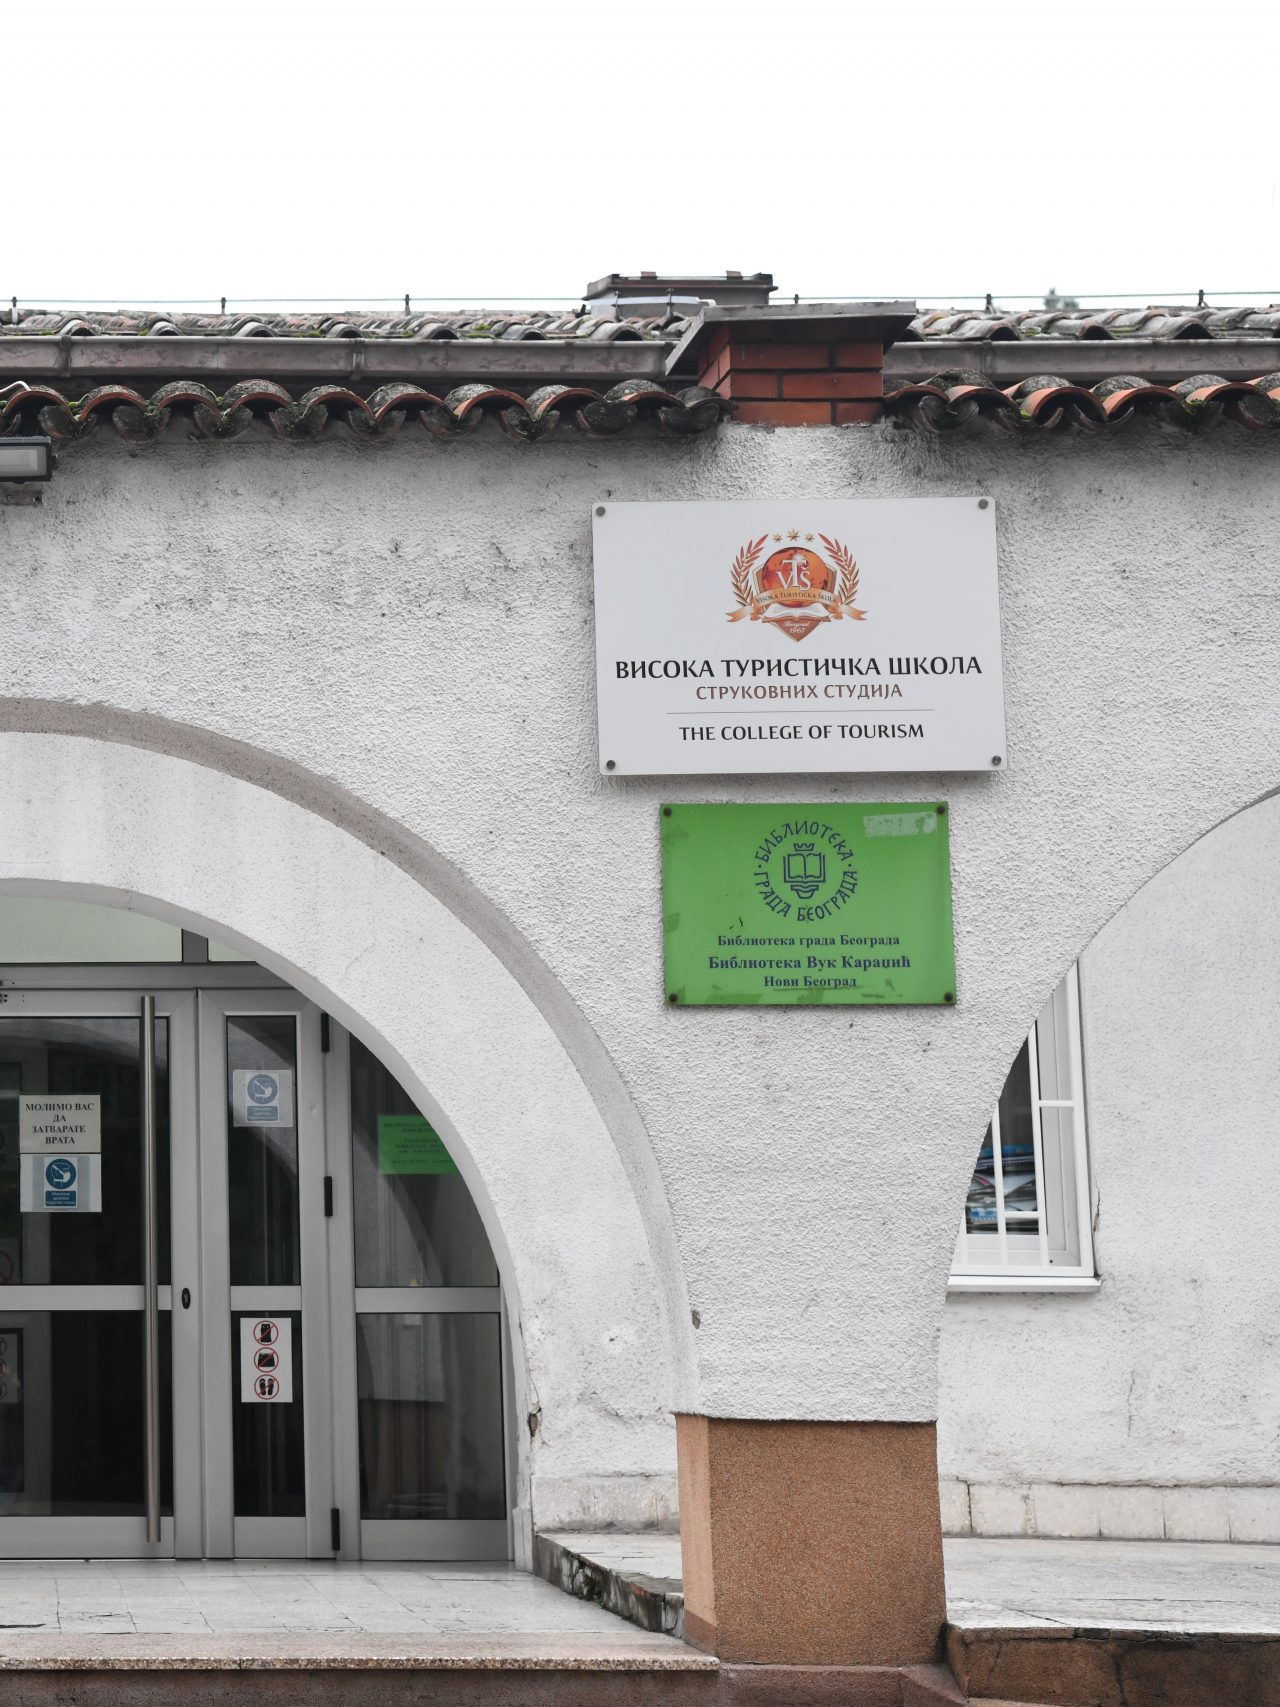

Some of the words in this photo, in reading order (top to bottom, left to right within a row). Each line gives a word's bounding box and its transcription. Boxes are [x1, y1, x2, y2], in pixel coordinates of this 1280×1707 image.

[616, 659, 714, 679] ВИСОКА
[721, 657, 881, 678] ТУРИСТИЧКА
[888, 655, 982, 676] ШКОЛА
[695, 684, 818, 701] СТРУКОВНИХ
[823, 683, 903, 701] СТУДИЈА
[678, 726, 715, 741] THE
[721, 725, 803, 741] COLLEGE
[808, 724, 832, 740] OF
[837, 723, 924, 739] TOURISM
[754, 820, 854, 864] БИБЛИОТЕКА
[753, 870, 792, 919] ГРАДА
[796, 869, 858, 922] БЕОГРАДА
[717, 934, 795, 946] Библиотека
[799, 936, 836, 949] града
[840, 934, 900, 949] Београда
[708, 955, 802, 969] Библиотека
[806, 955, 837, 972] Вук
[841, 955, 911, 971] Караџић
[763, 975, 799, 988] Нови
[803, 975, 857, 990] Београд
[25, 1103, 73, 1111] МОЛИМО
[75, 1102, 95, 1111] ВАС
[52, 1114, 66, 1123] ДА
[31, 1125, 86, 1133] ЗАТВАРАТЕ
[45, 1136, 75, 1145] ВРАТА
